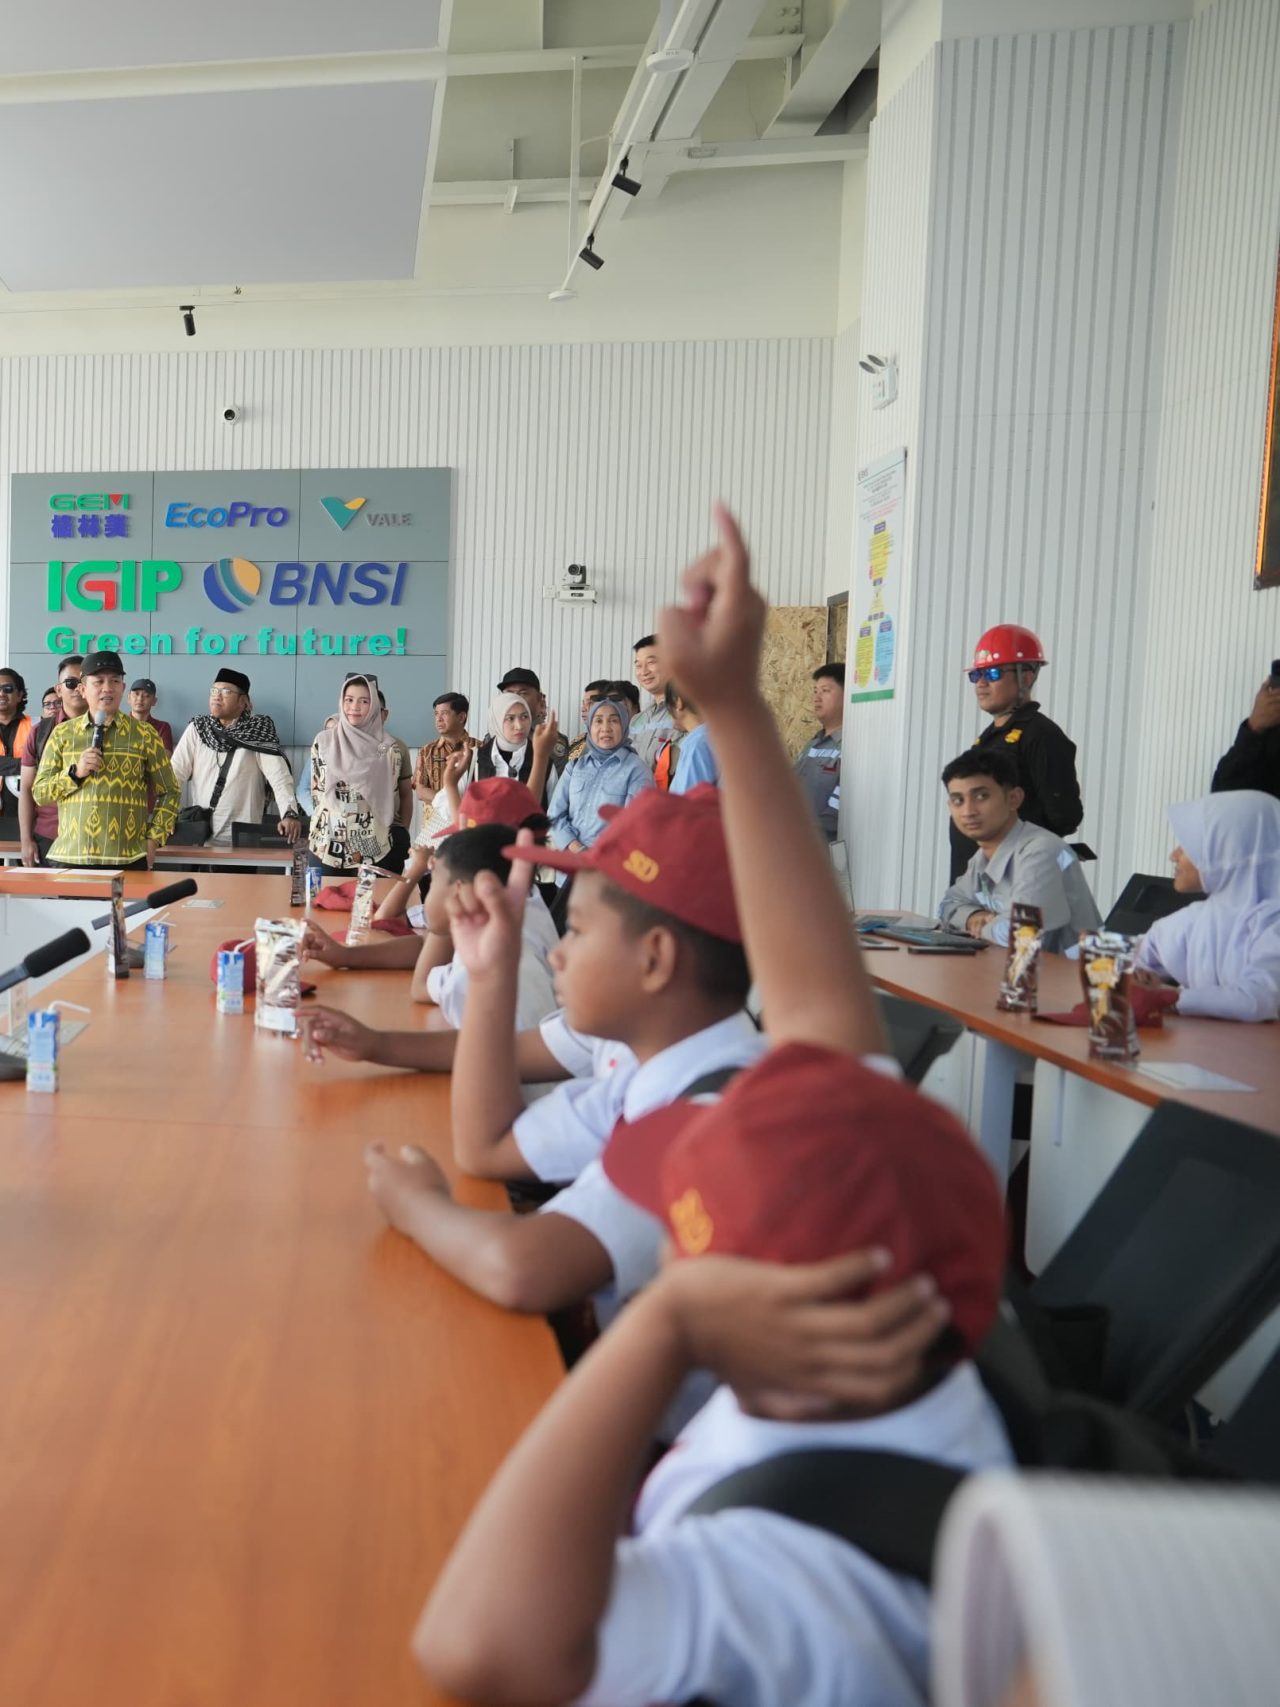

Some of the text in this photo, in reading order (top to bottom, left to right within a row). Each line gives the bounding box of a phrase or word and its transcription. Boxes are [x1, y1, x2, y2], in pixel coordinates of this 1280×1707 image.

[49, 492, 129, 511] GEM
[165, 501, 290, 528] EcoPro
[367, 512, 413, 527] VALE
[48, 560, 183, 612] IGIP
[270, 562, 409, 606] BNSI
[47, 626, 407, 656] Green for future!
[350, 829, 373, 837] Dior
